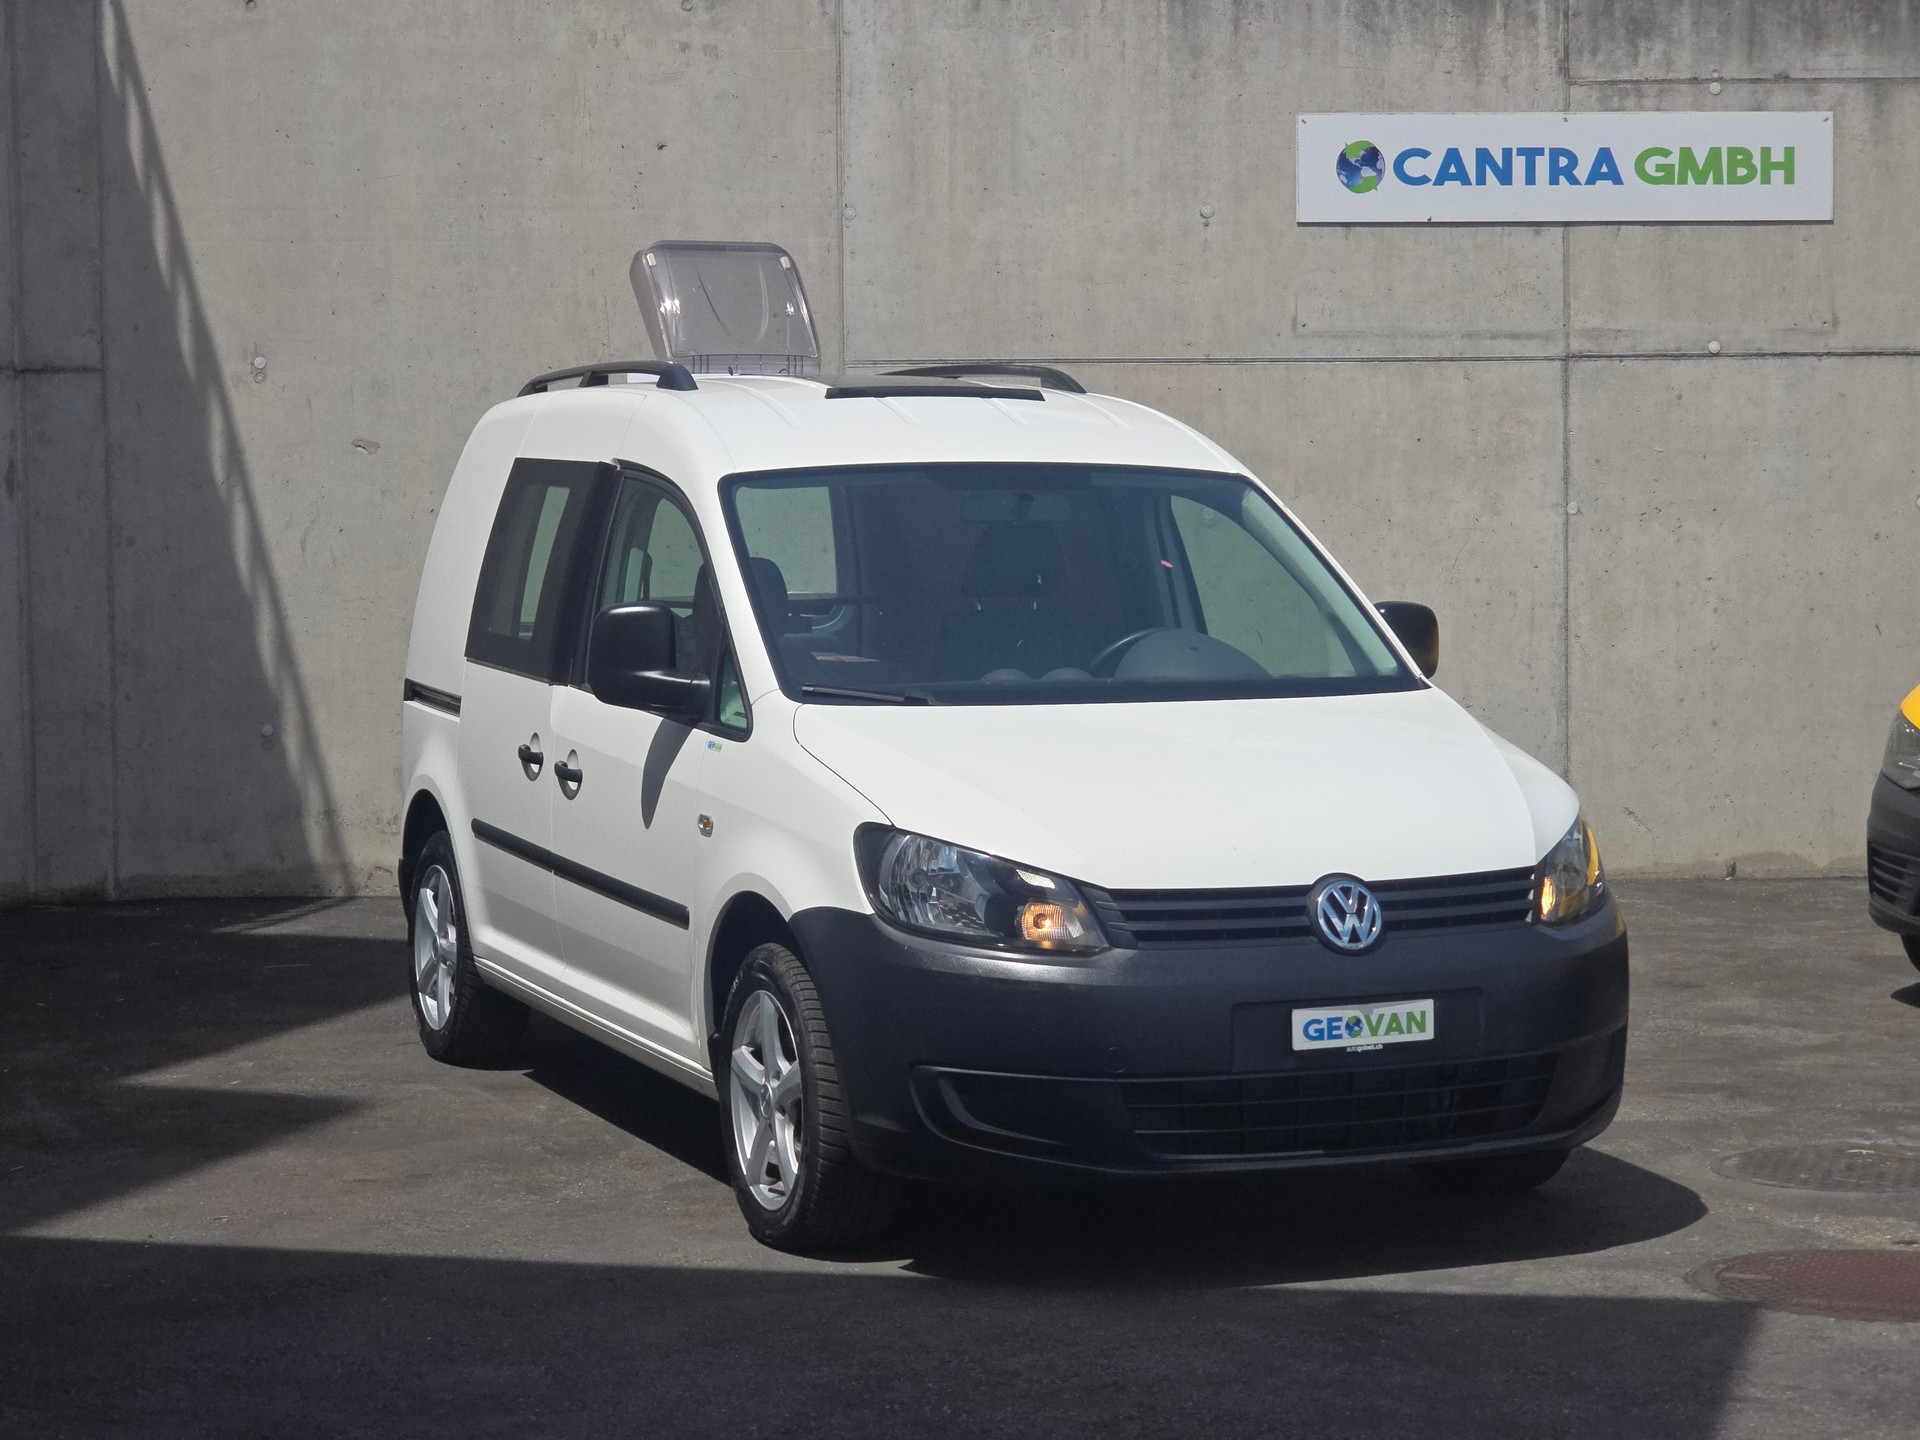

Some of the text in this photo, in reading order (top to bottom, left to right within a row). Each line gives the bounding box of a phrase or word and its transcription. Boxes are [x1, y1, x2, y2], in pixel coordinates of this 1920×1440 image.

[1393, 146, 1796, 187] CANTRA GMBH
[1302, 1010, 1427, 1042] GEOVAN
